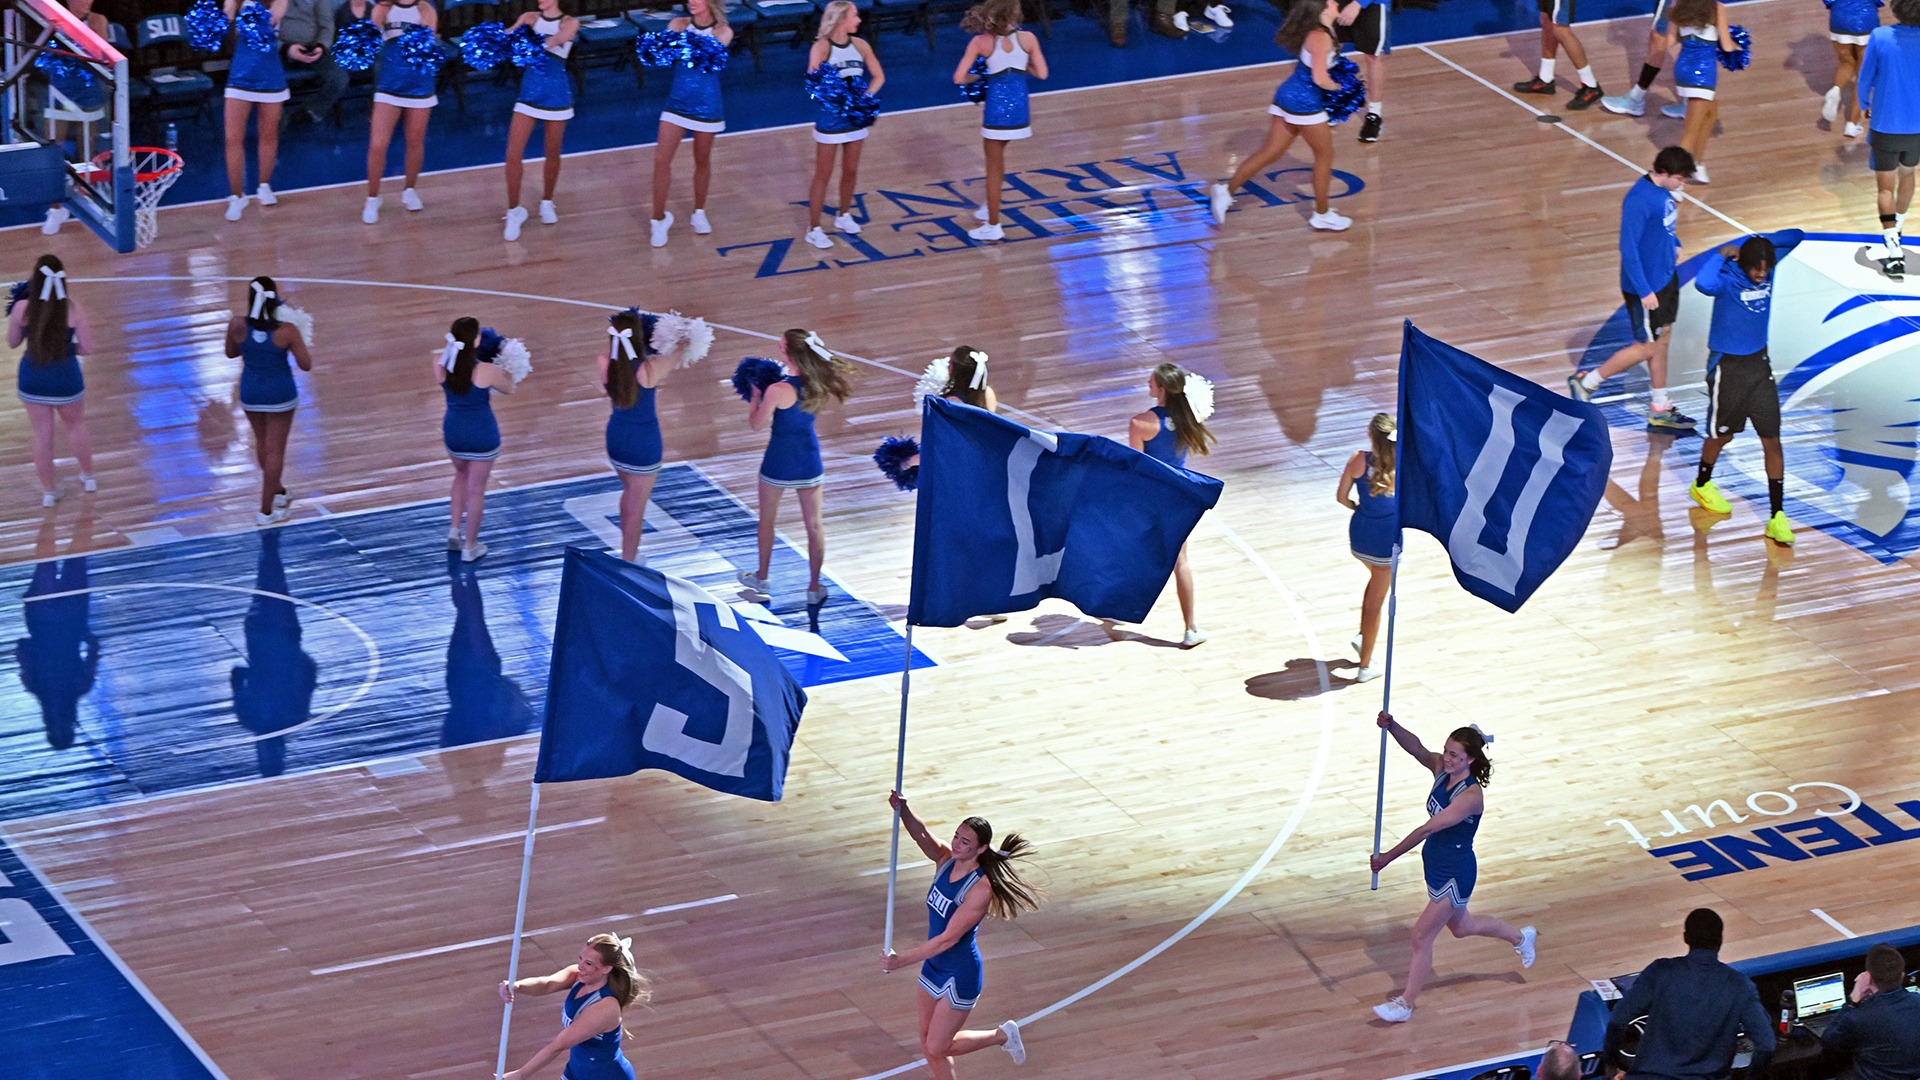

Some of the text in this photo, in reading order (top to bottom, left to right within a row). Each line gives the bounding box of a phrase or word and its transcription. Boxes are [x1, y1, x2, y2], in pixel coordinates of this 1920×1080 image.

[146, 17, 180, 39] SLU
[715, 166, 1366, 279] CHAIFETZ
[788, 150, 1188, 225] ARENA
[1007, 428, 1066, 597] L
[1448, 383, 1586, 596] U
[1604, 781, 1862, 850] Court
[1647, 799, 1920, 882] TENE
[928, 889, 949, 914] SLU
